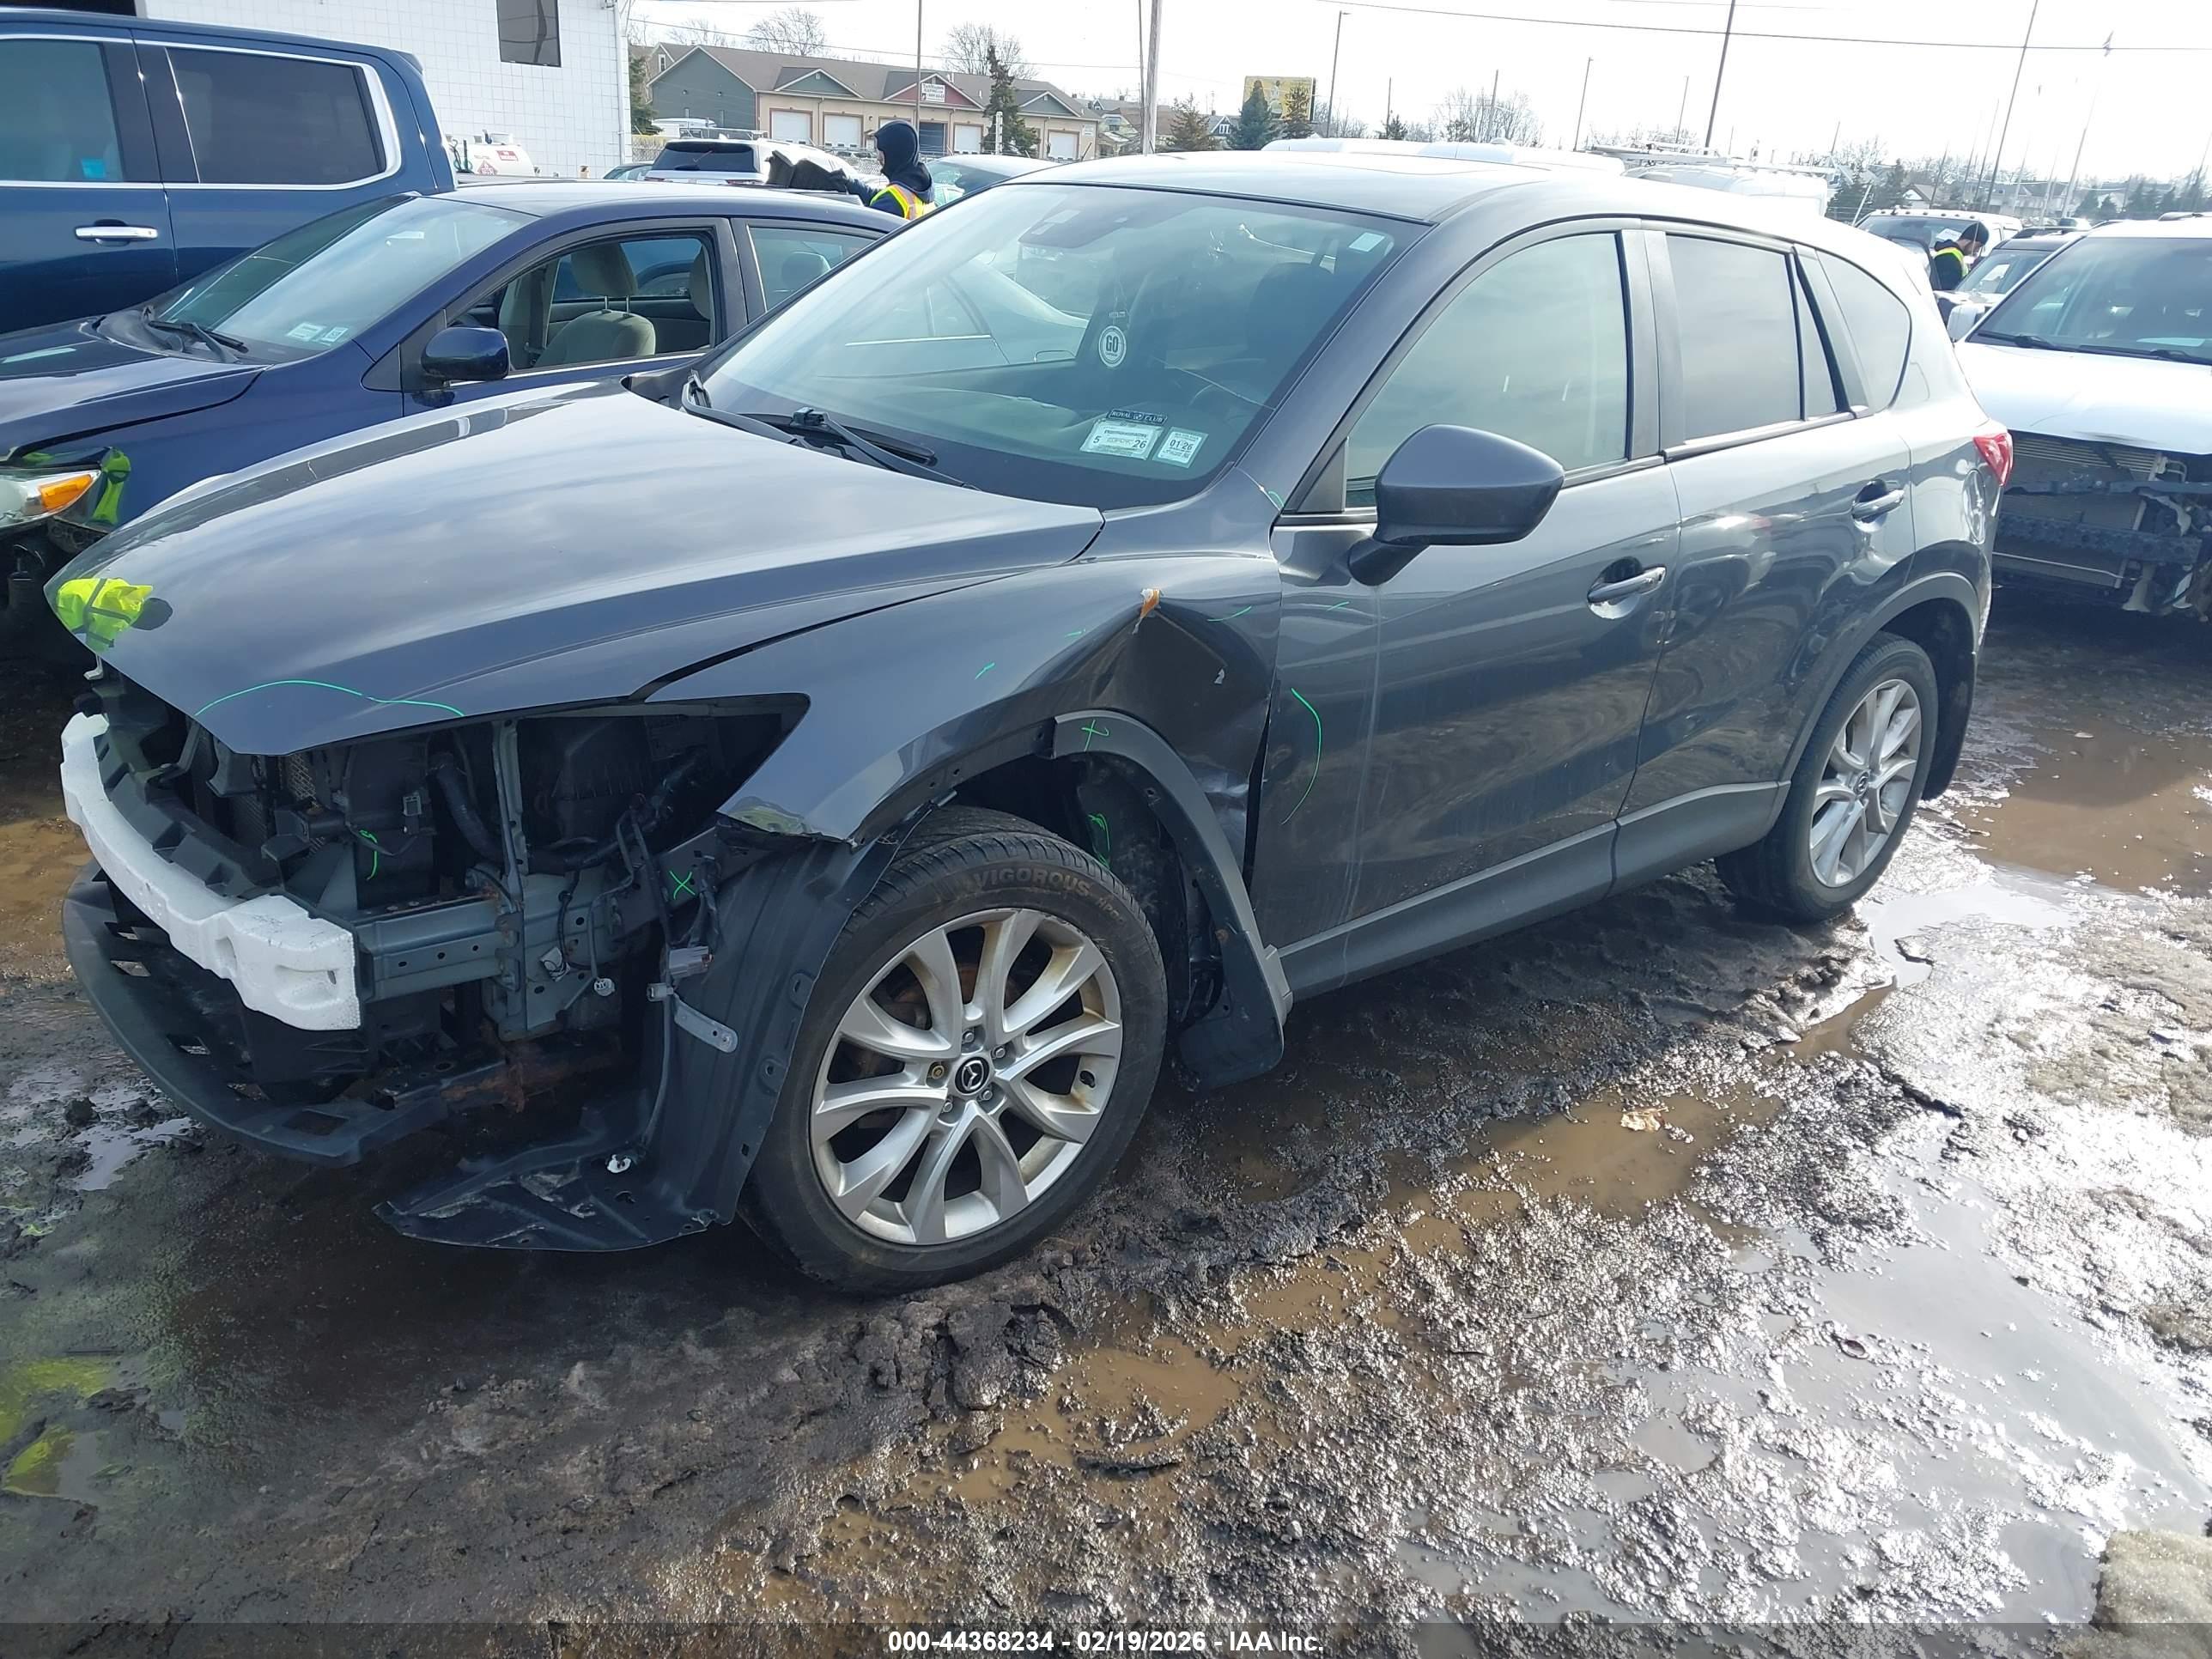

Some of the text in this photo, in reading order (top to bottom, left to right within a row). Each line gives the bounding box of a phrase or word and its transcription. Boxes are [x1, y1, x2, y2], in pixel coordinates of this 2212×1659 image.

[1106, 335, 1119, 353] GO
[1092, 435, 1102, 444] 5
[1133, 439, 1147, 449] 26
[975, 867, 1091, 896] VIGOROUS
